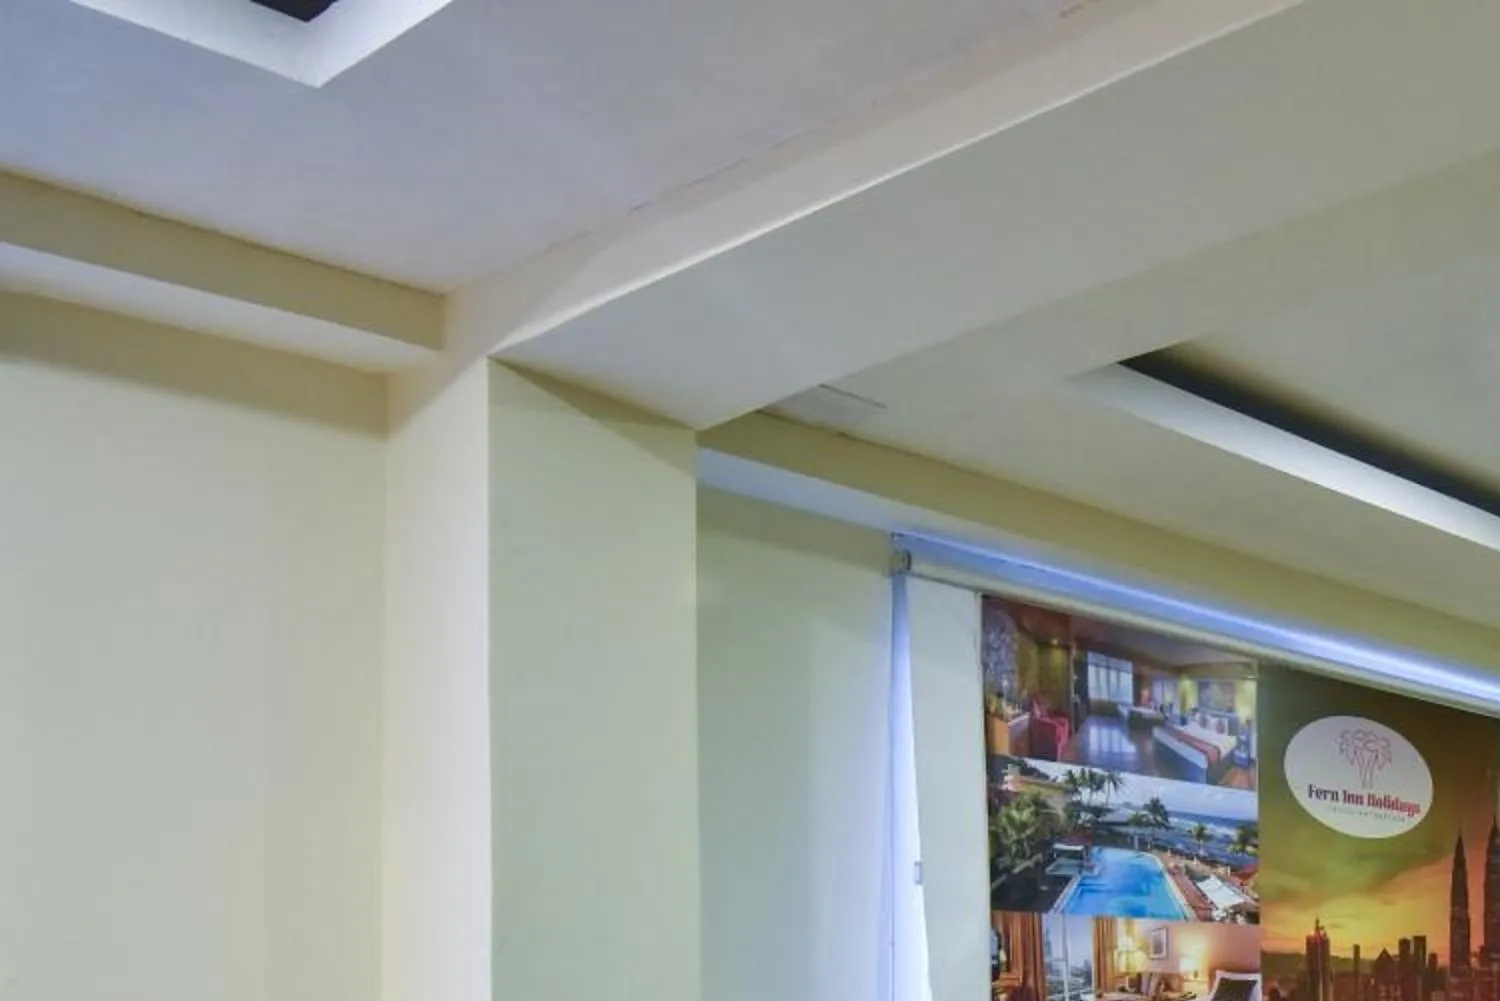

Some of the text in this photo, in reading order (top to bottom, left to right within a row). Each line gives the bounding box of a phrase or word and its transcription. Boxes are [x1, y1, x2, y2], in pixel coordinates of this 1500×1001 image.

[1308, 784, 1339, 801] Fern
[1343, 790, 1364, 805] Inn
[1367, 793, 1421, 817] Holidays
